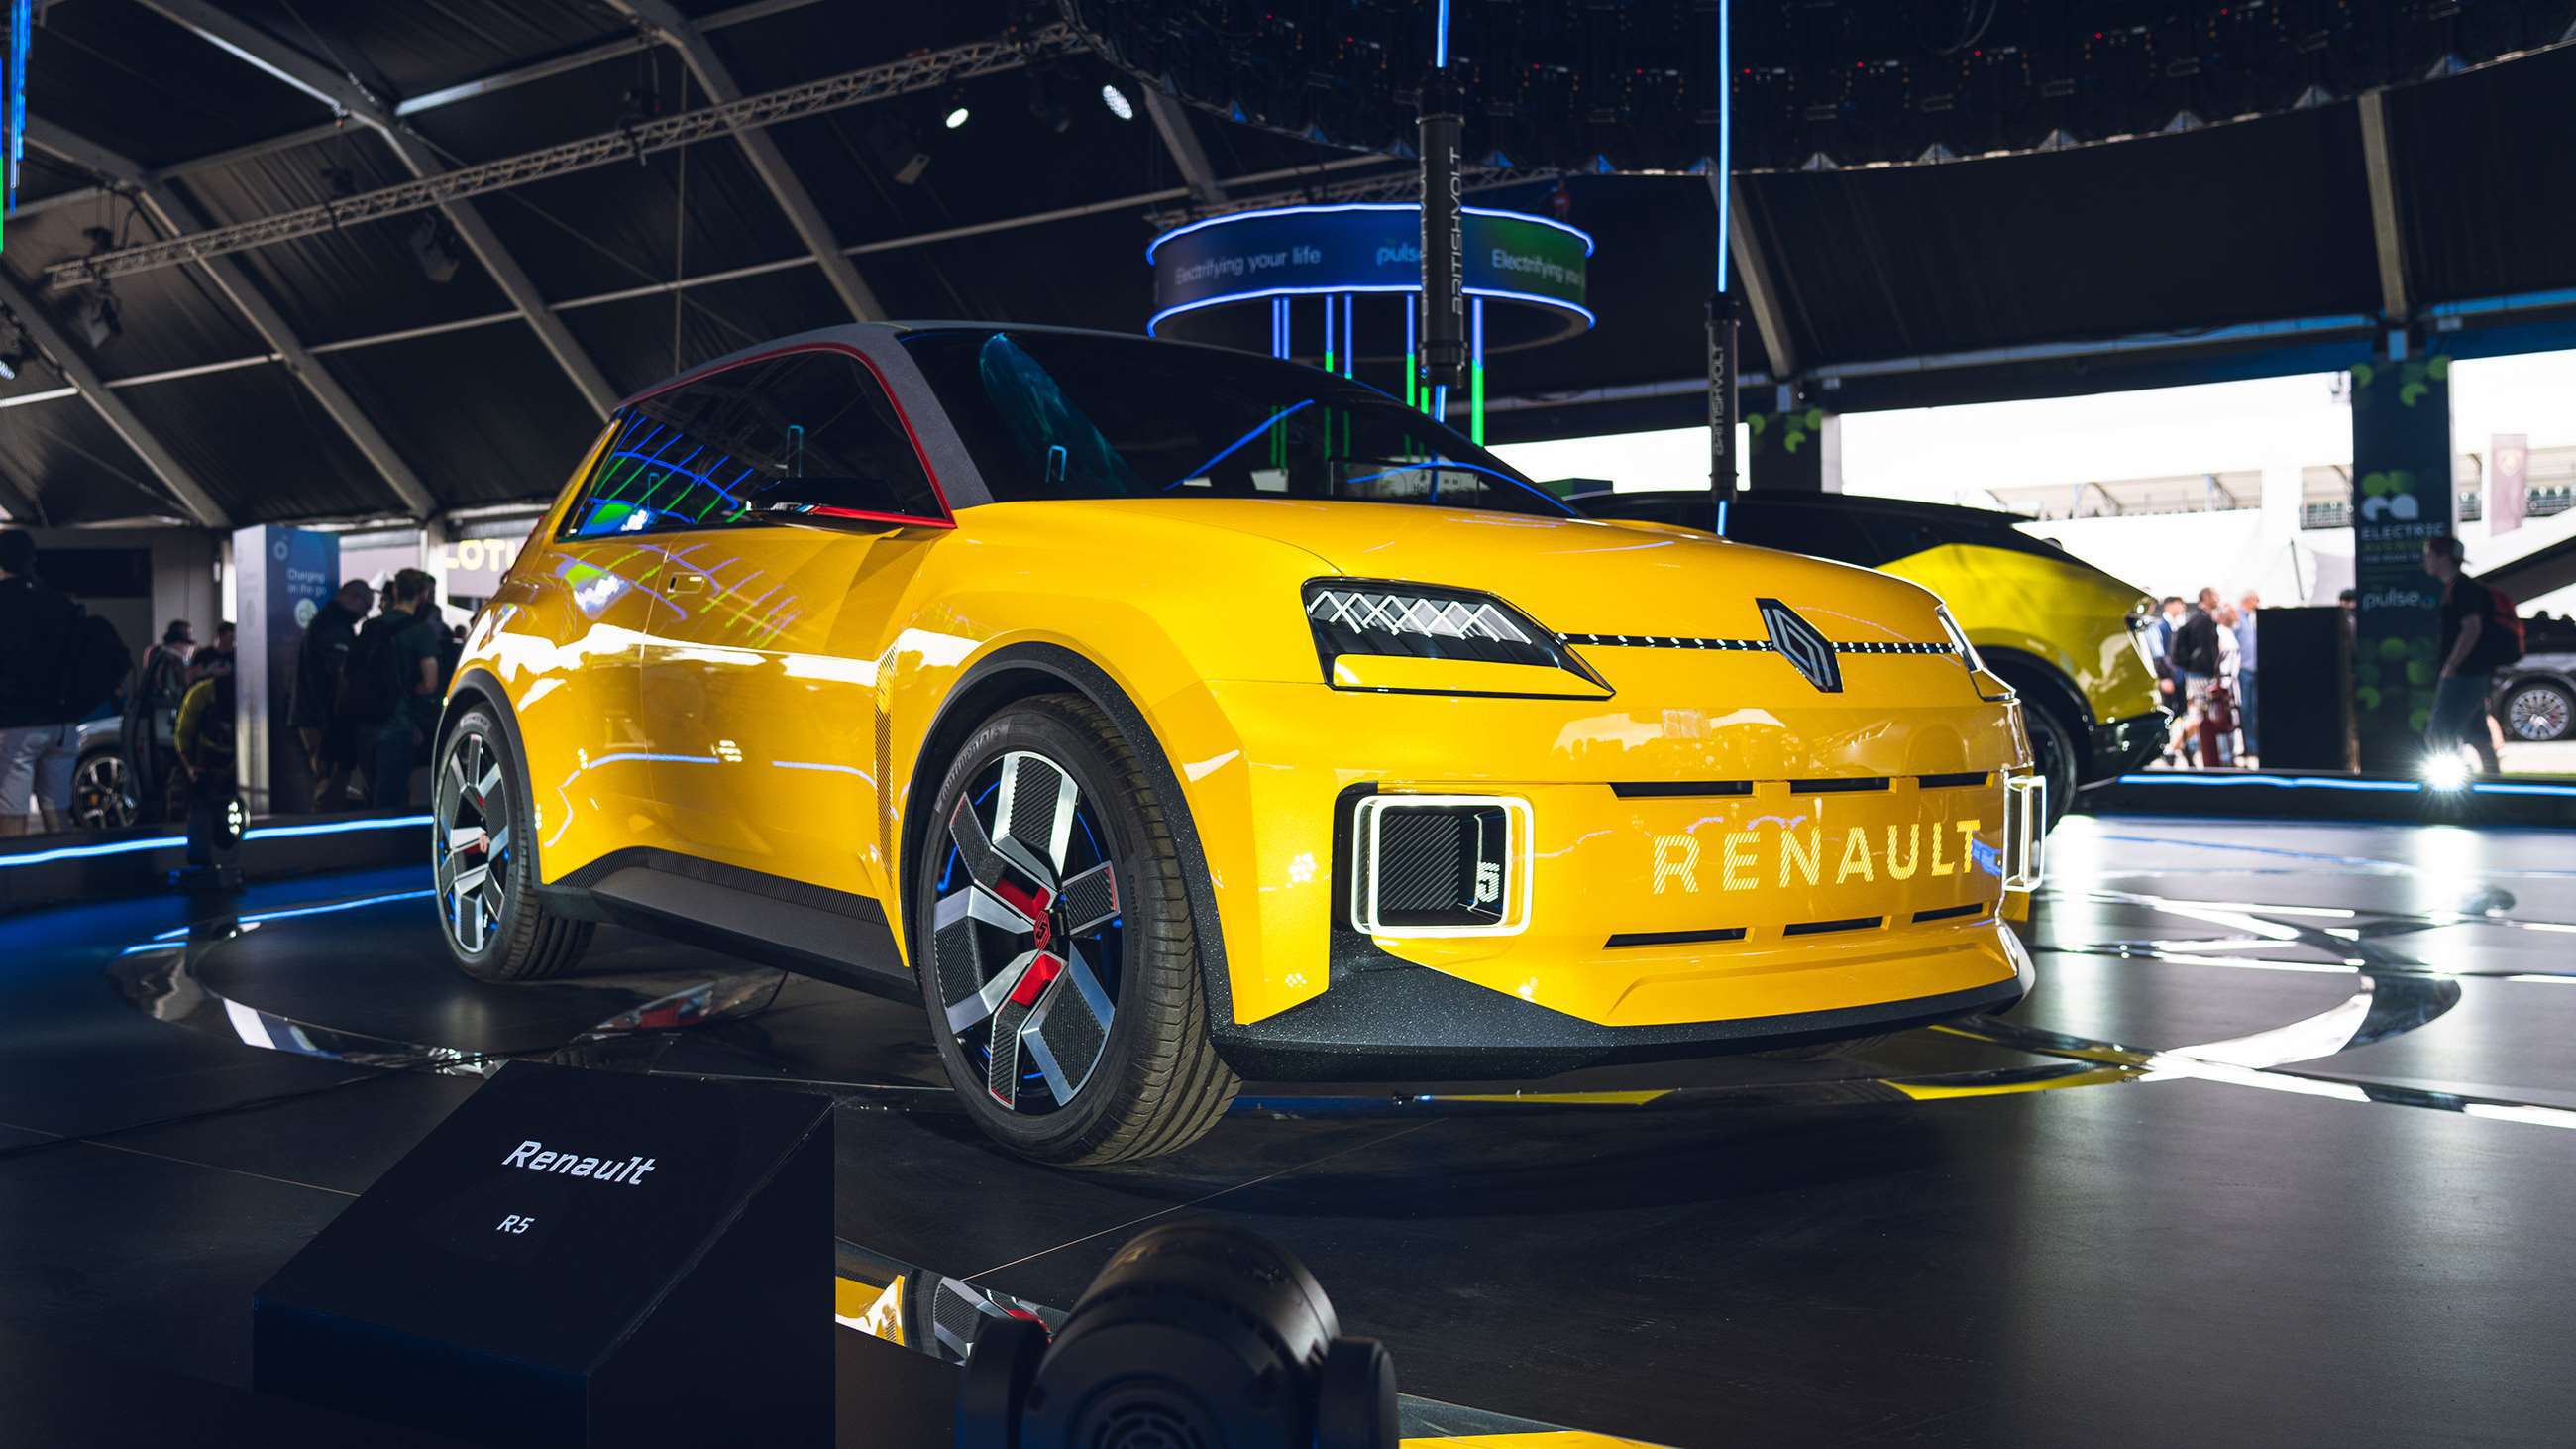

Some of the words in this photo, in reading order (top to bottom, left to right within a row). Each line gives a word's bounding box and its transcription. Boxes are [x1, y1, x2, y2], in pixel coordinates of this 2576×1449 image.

[1247, 251, 1289, 274] your
[1292, 245, 1323, 266] life
[1375, 242, 1421, 267] puls
[2361, 522, 2442, 540] ELECTRIC
[2362, 587, 2420, 613] pulse
[1652, 819, 1981, 895] RENAULT
[1476, 861, 1500, 903] 5
[501, 1140, 657, 1186] Renault
[495, 1214, 536, 1235] R5
